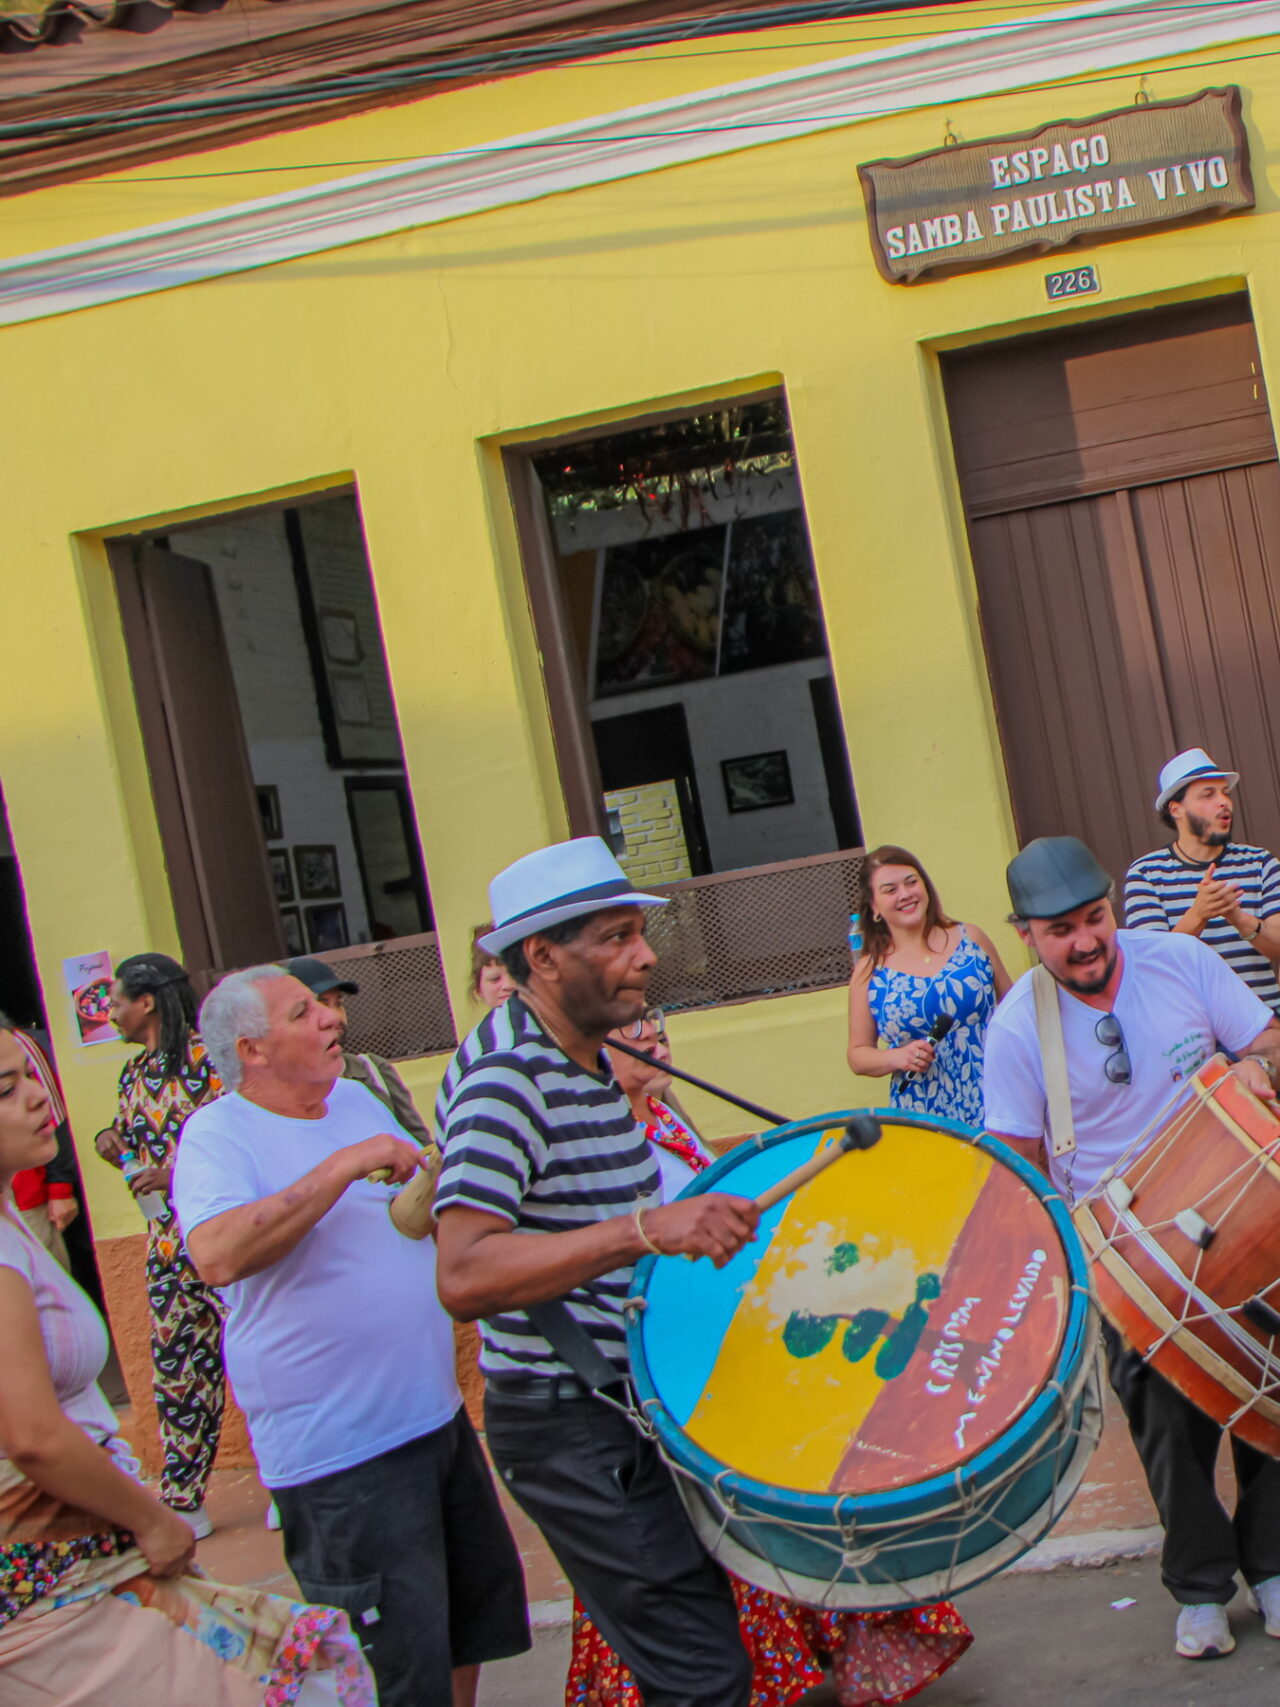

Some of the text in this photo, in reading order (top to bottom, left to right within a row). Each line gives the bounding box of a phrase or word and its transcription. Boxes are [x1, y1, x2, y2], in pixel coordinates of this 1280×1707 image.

[990, 134, 1111, 190] ESPAÇO
[886, 155, 1229, 260] SAMBA PAULISTA VIVO
[1050, 268, 1092, 297] 226
[1002, 1248, 1048, 1323] LEVADO
